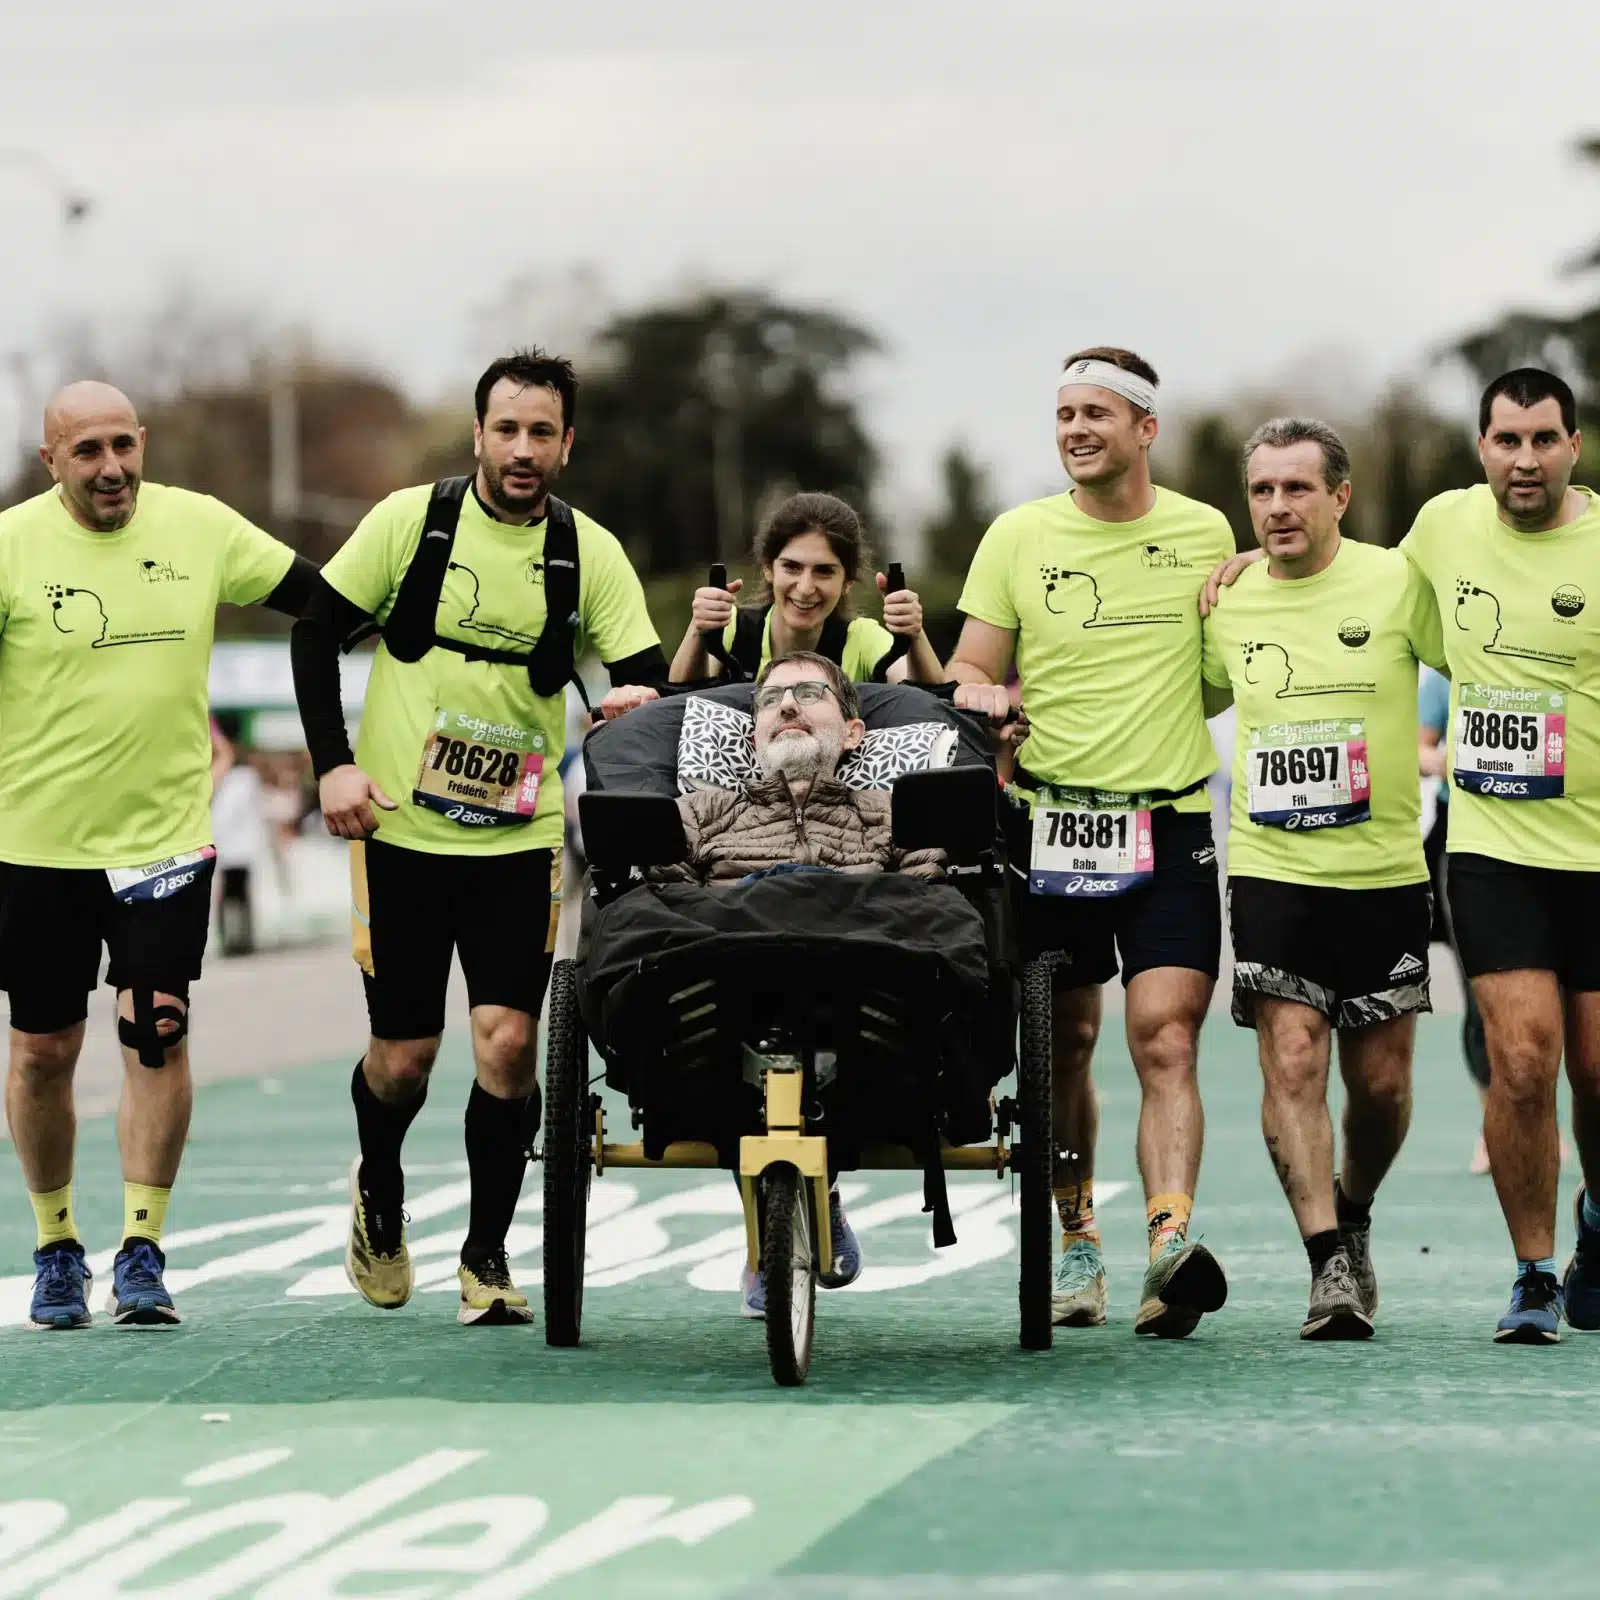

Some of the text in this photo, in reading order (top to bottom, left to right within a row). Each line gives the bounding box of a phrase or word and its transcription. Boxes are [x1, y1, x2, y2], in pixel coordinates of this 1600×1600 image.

[1555, 592, 1582, 602] SPORT
[1556, 600, 1579, 608] 2000
[1145, 612, 1183, 620] amyotrophique
[1552, 617, 1576, 625] CHALON
[1341, 625, 1367, 633] SPORT
[1538, 650, 1577, 661] amyotrophique
[1474, 683, 1542, 702] Schneider
[1500, 700, 1539, 710] Electric
[457, 714, 528, 741] Schneider
[1268, 720, 1340, 737] Schneider
[1462, 710, 1538, 751] 78865
[486, 734, 525, 749] Electric
[1299, 732, 1340, 743] Electric
[431, 735, 519, 787] 78628
[1256, 746, 1339, 787] 78697
[1477, 758, 1514, 772] Baptiste
[447, 780, 489, 799] Frédéric
[1493, 781, 1529, 794] asics
[1292, 794, 1308, 807] Fifi
[461, 810, 498, 826] asics
[1302, 812, 1337, 827] asics
[1046, 812, 1127, 849] 78381
[141, 857, 177, 876] Laurent
[1072, 858, 1097, 871] Baba
[167, 870, 196, 890] asics
[1083, 879, 1118, 892] asics
[1389, 973, 1406, 981] NIKE
